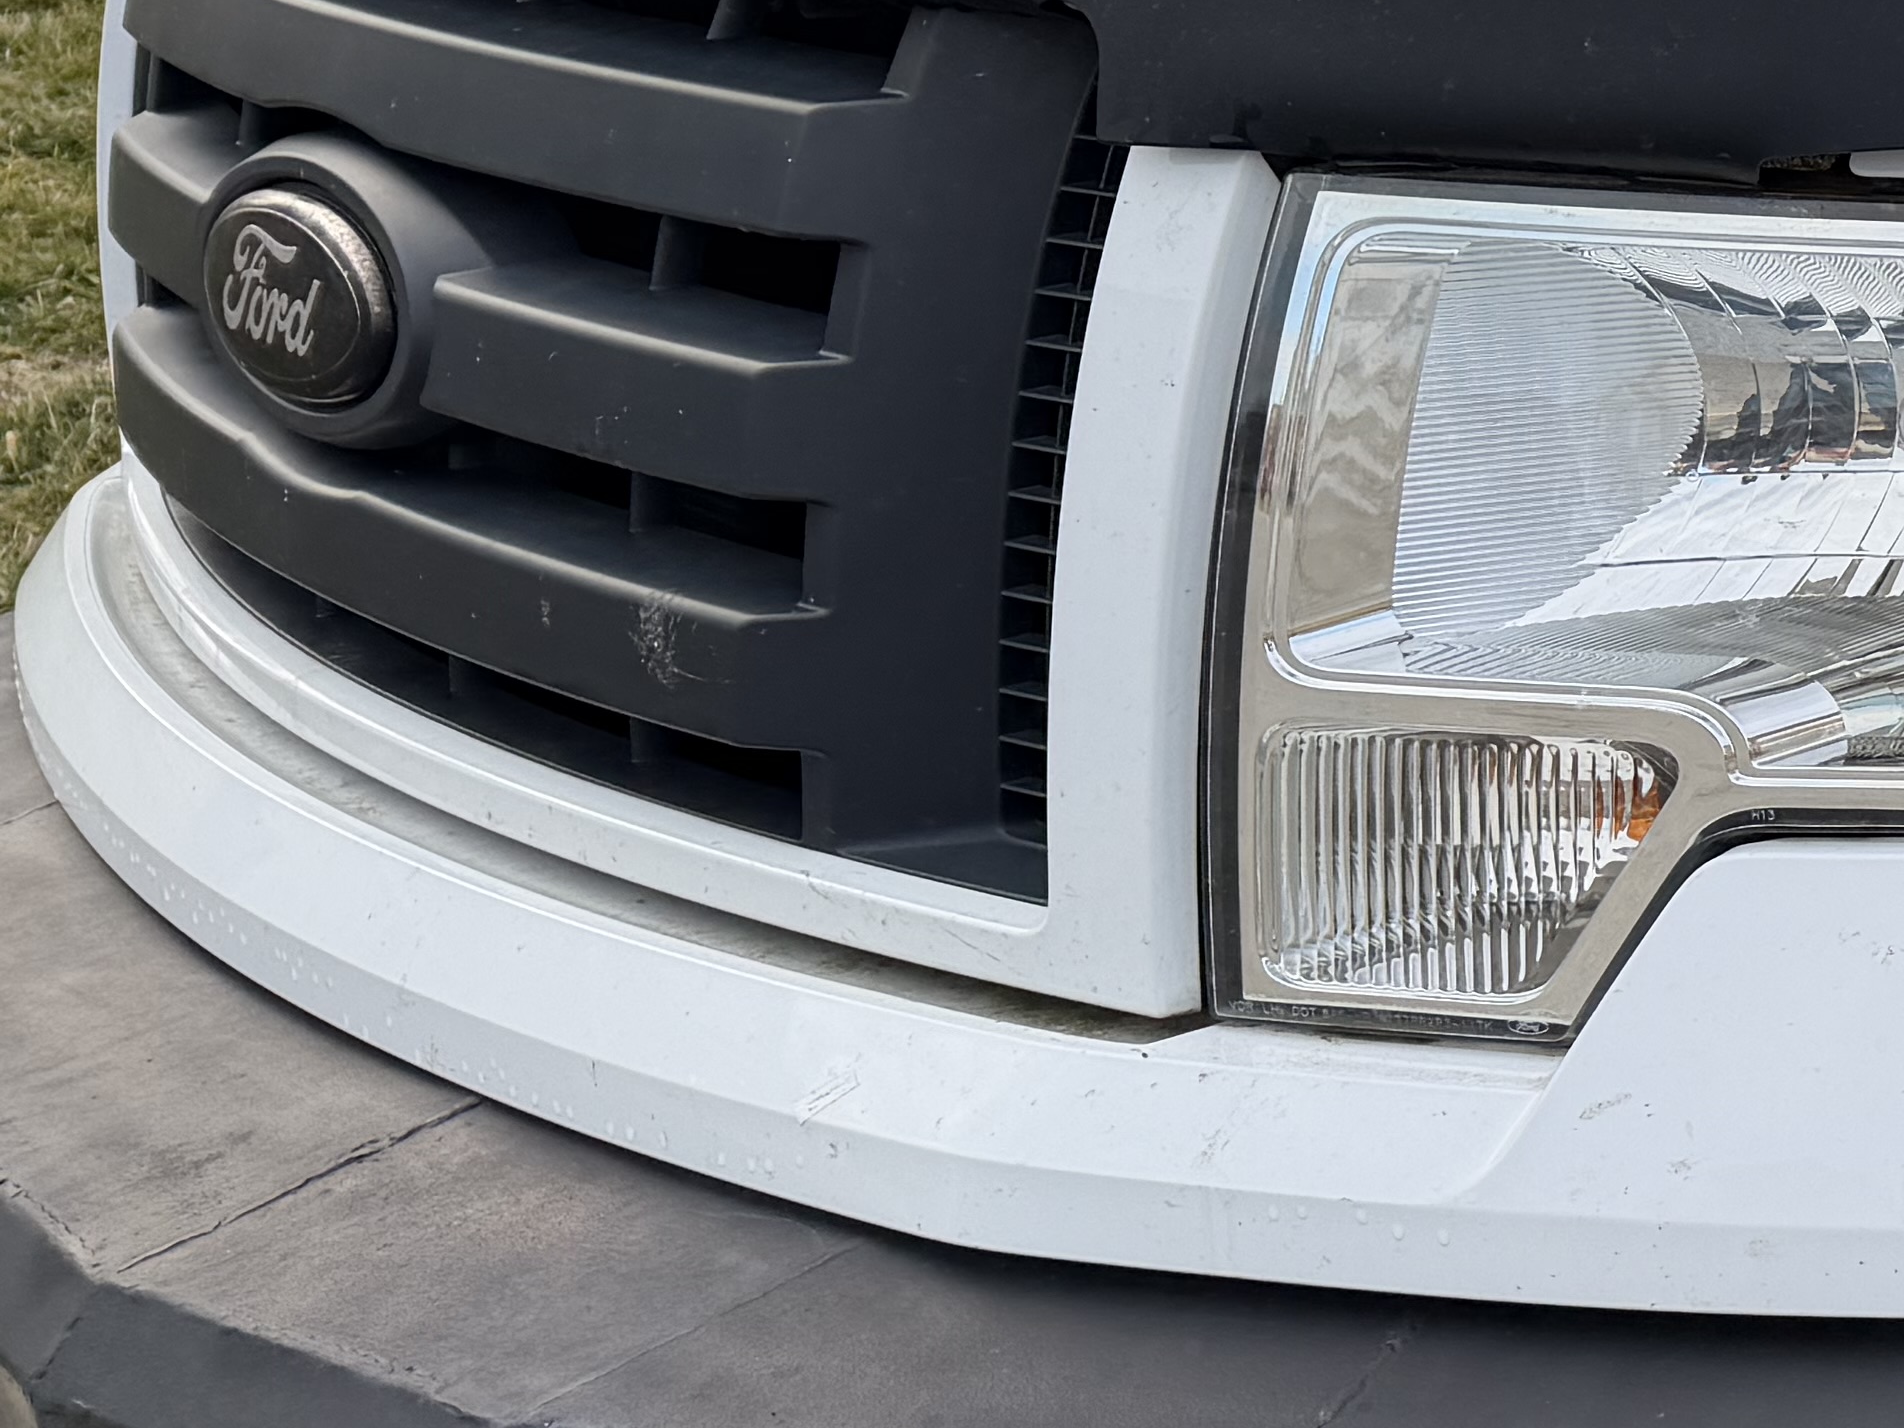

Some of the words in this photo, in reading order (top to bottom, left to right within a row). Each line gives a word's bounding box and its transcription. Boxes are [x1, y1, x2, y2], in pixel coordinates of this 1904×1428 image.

[222, 224, 321, 357] Ford
[1751, 809, 1775, 821] H13
[1292, 1005, 1317, 1018] DOT
